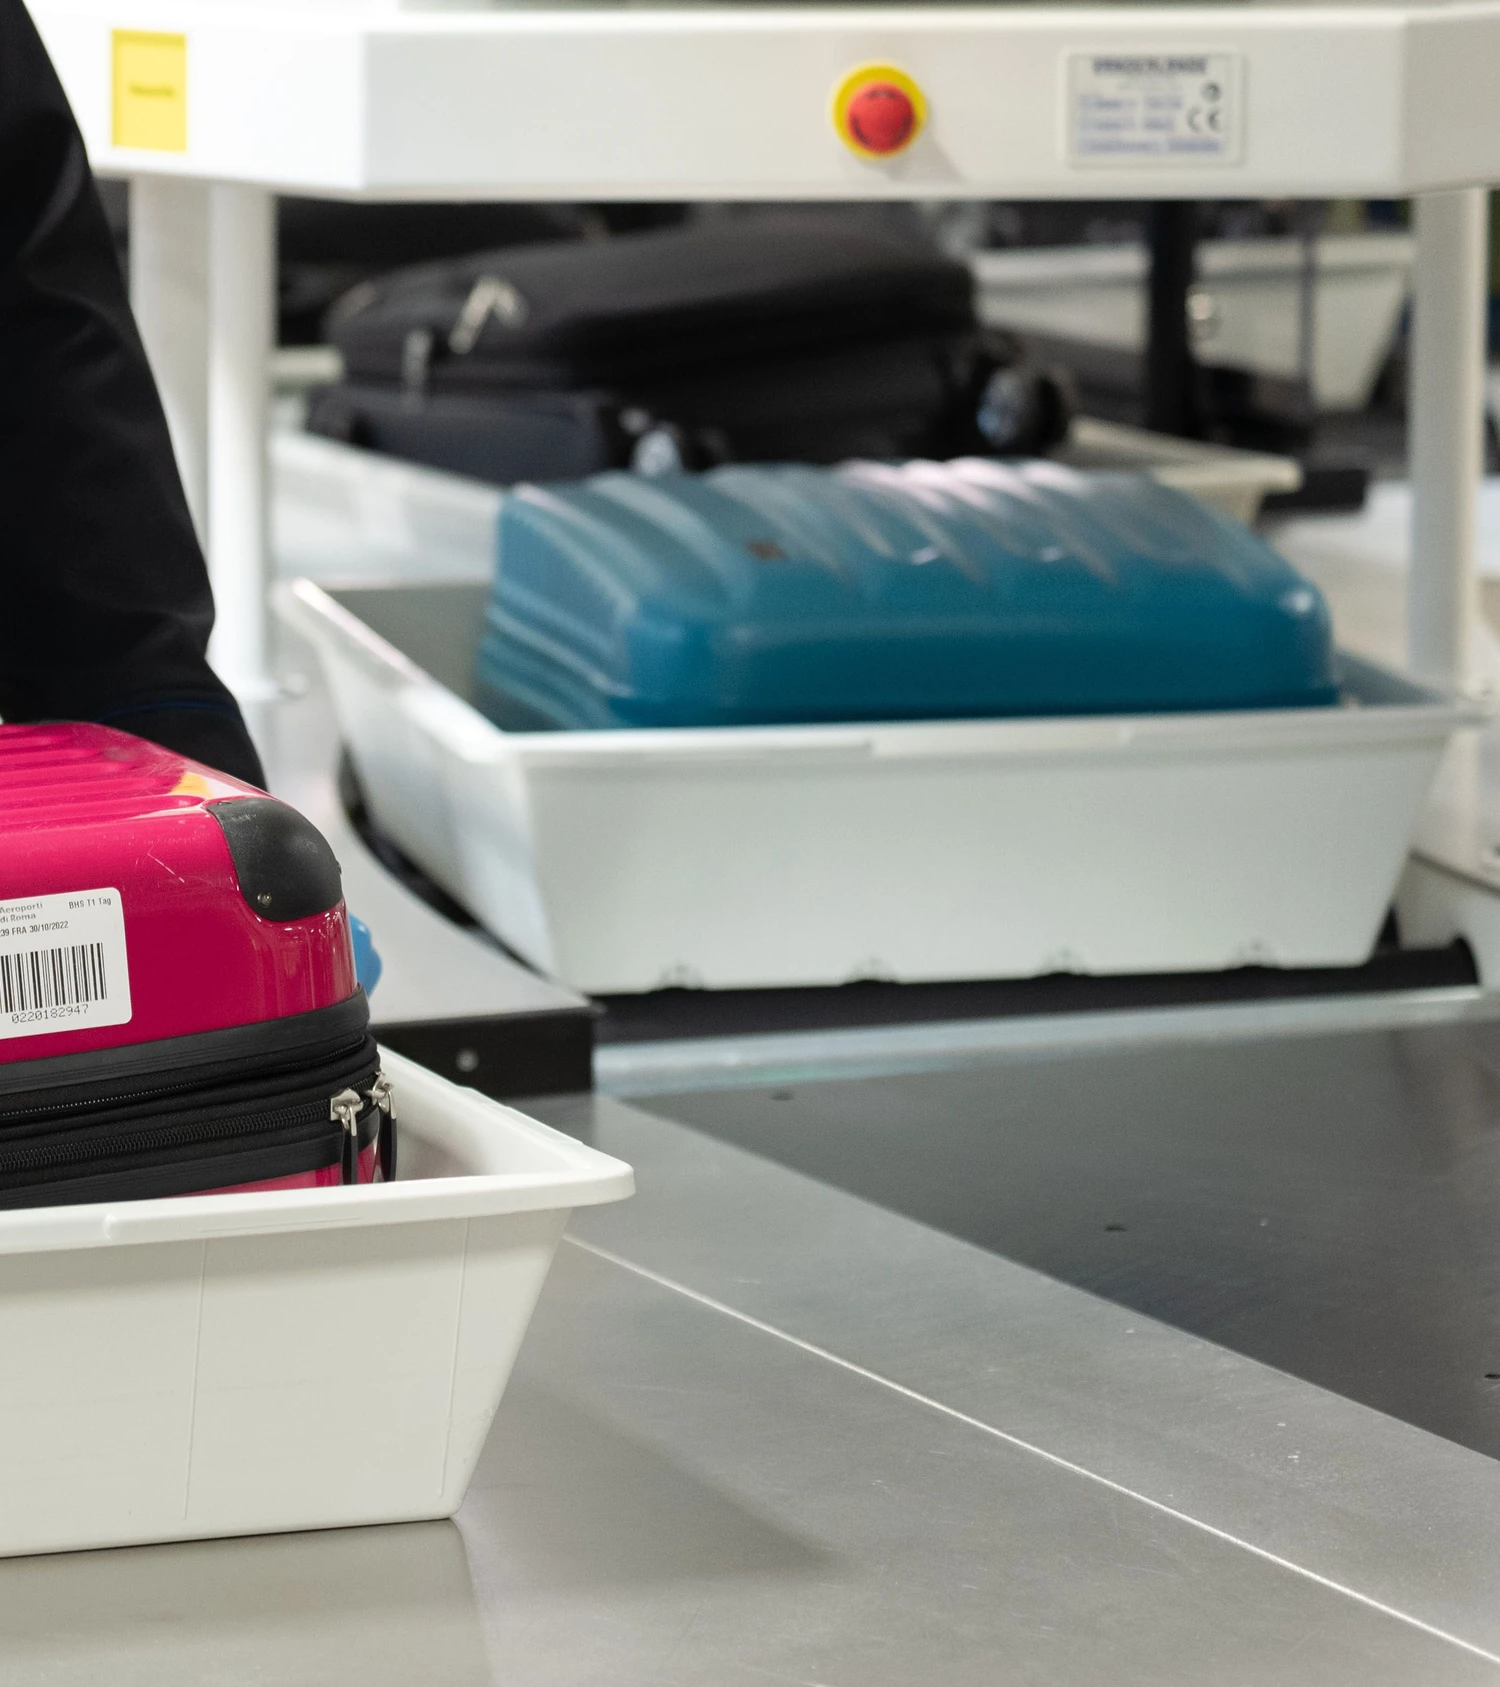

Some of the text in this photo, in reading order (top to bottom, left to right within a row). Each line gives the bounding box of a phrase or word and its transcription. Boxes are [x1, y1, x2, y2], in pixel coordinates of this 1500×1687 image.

[0, 902, 43, 914] Aeroporti
[69, 897, 112, 909] BHS T1 Tag
[0, 913, 37, 924] di Roma
[11, 926, 27, 936] FRA
[29, 921, 68, 933] 30/10/2022
[11, 1004, 89, 1024] 0220182947
